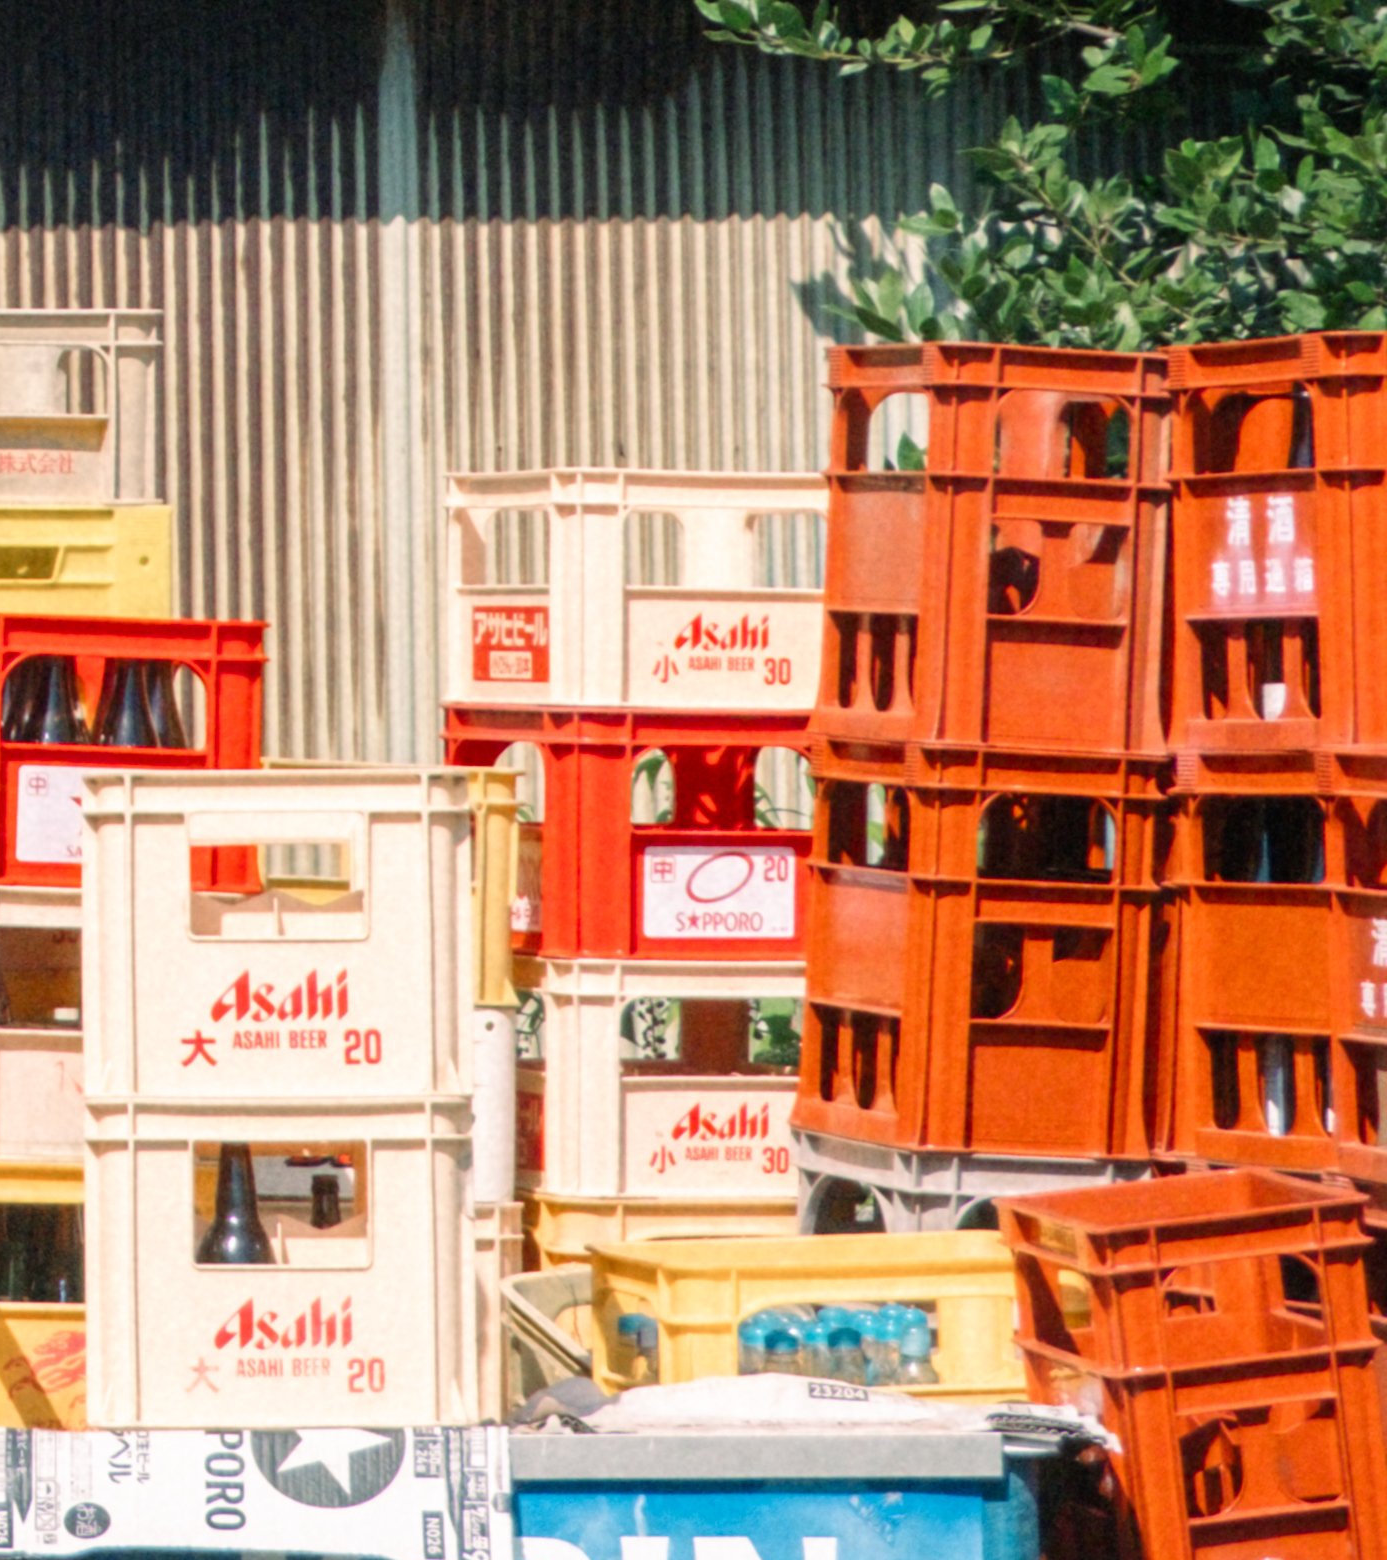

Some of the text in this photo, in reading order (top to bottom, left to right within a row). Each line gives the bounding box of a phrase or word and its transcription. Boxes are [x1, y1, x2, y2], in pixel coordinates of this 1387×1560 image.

[473, 612, 547, 647] アサヒビール
[674, 613, 769, 652] Asahi
[653, 654, 792, 685] 小 ASAHI BEER 30
[28, 775, 47, 795] 中
[653, 856, 788, 882] 中 20
[210, 968, 348, 1023] Asahi
[181, 1028, 382, 1067] 大 ASAHI BEER 20
[671, 1102, 769, 1141] Asahi
[649, 1145, 676, 1174] 小
[762, 1147, 789, 1174] 30
[214, 1295, 352, 1350] Asahi
[185, 1356, 385, 1393] 大 ASAHI BEER 20
[812, 1384, 865, 1400] 23204
[426, 1517, 442, 1555] N026
